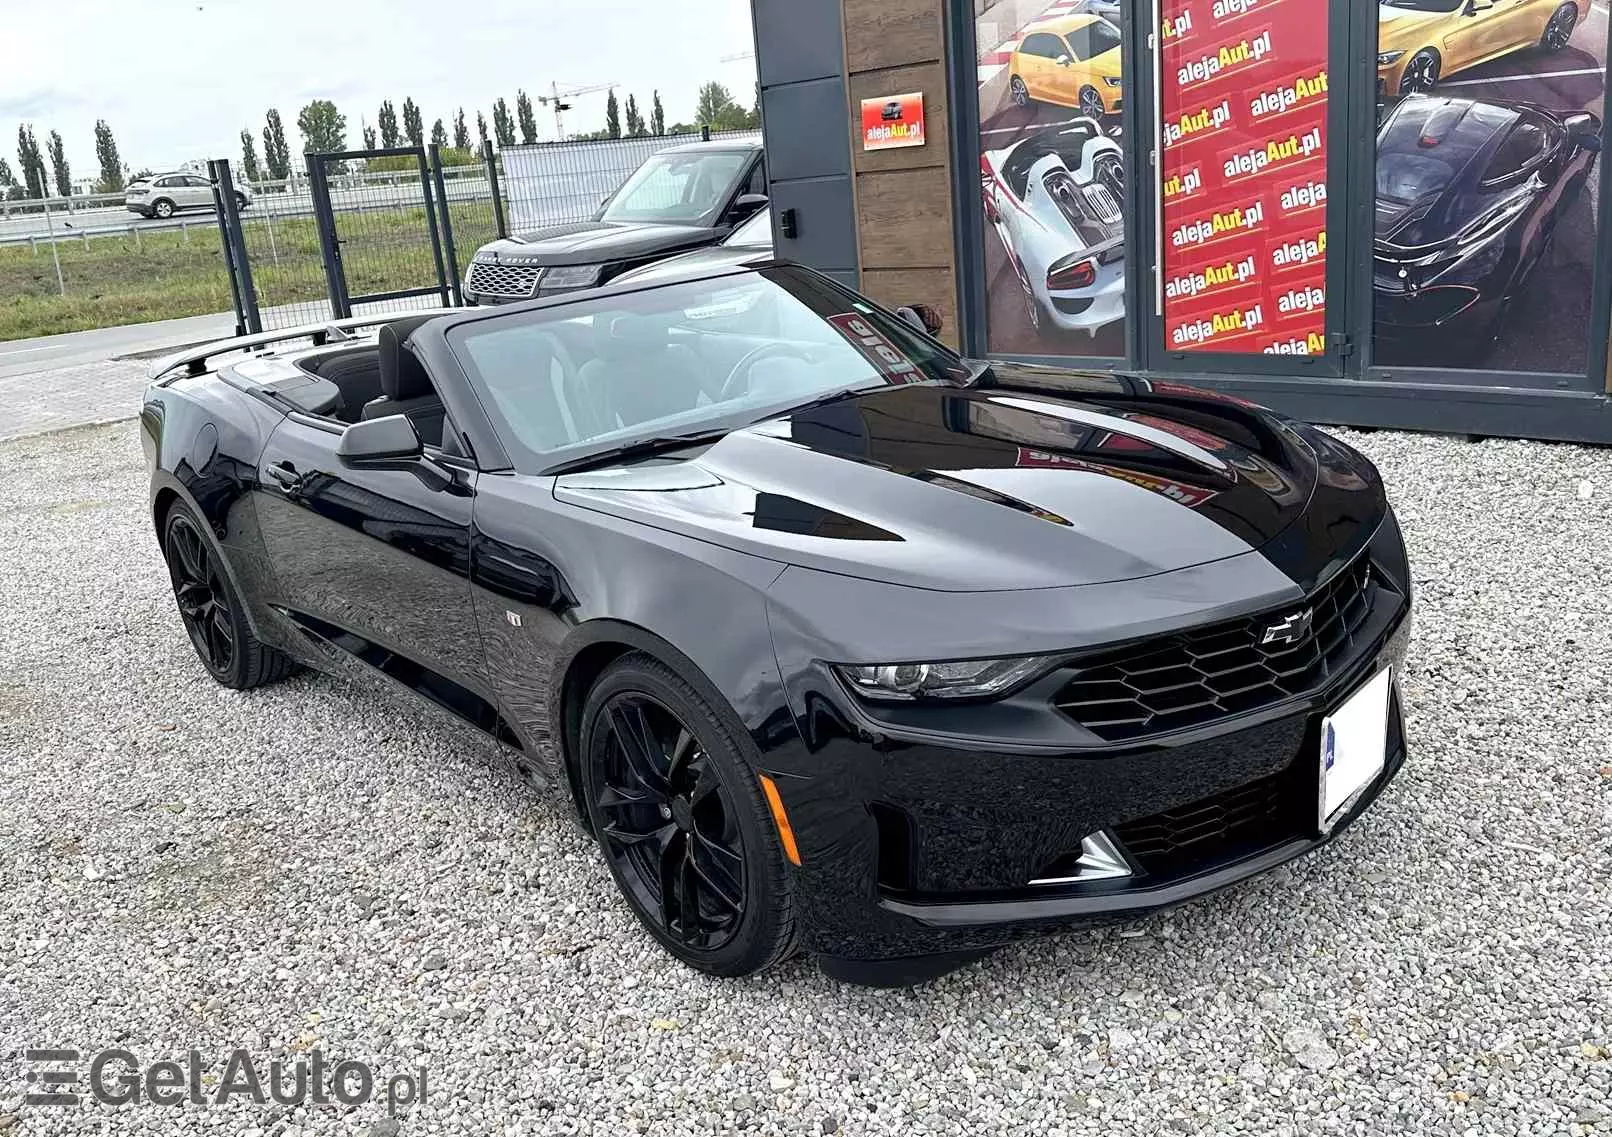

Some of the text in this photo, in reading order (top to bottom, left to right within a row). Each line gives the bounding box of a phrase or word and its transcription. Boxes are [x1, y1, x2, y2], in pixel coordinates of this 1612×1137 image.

[1177, 31, 1271, 84] alejaAut.pl
[1251, 71, 1328, 116] alejaAut
[867, 121, 920, 140] alejaAut.pl
[1163, 101, 1230, 146] jaAut.pl
[1224, 128, 1321, 177] alejaAut.pl
[1281, 182, 1327, 210] aleja
[1172, 202, 1263, 246] alejaAut.pl
[1166, 256, 1256, 298] alejaAut.pl
[1278, 286, 1325, 312] aleja
[1172, 305, 1263, 343] alejaAut.pl
